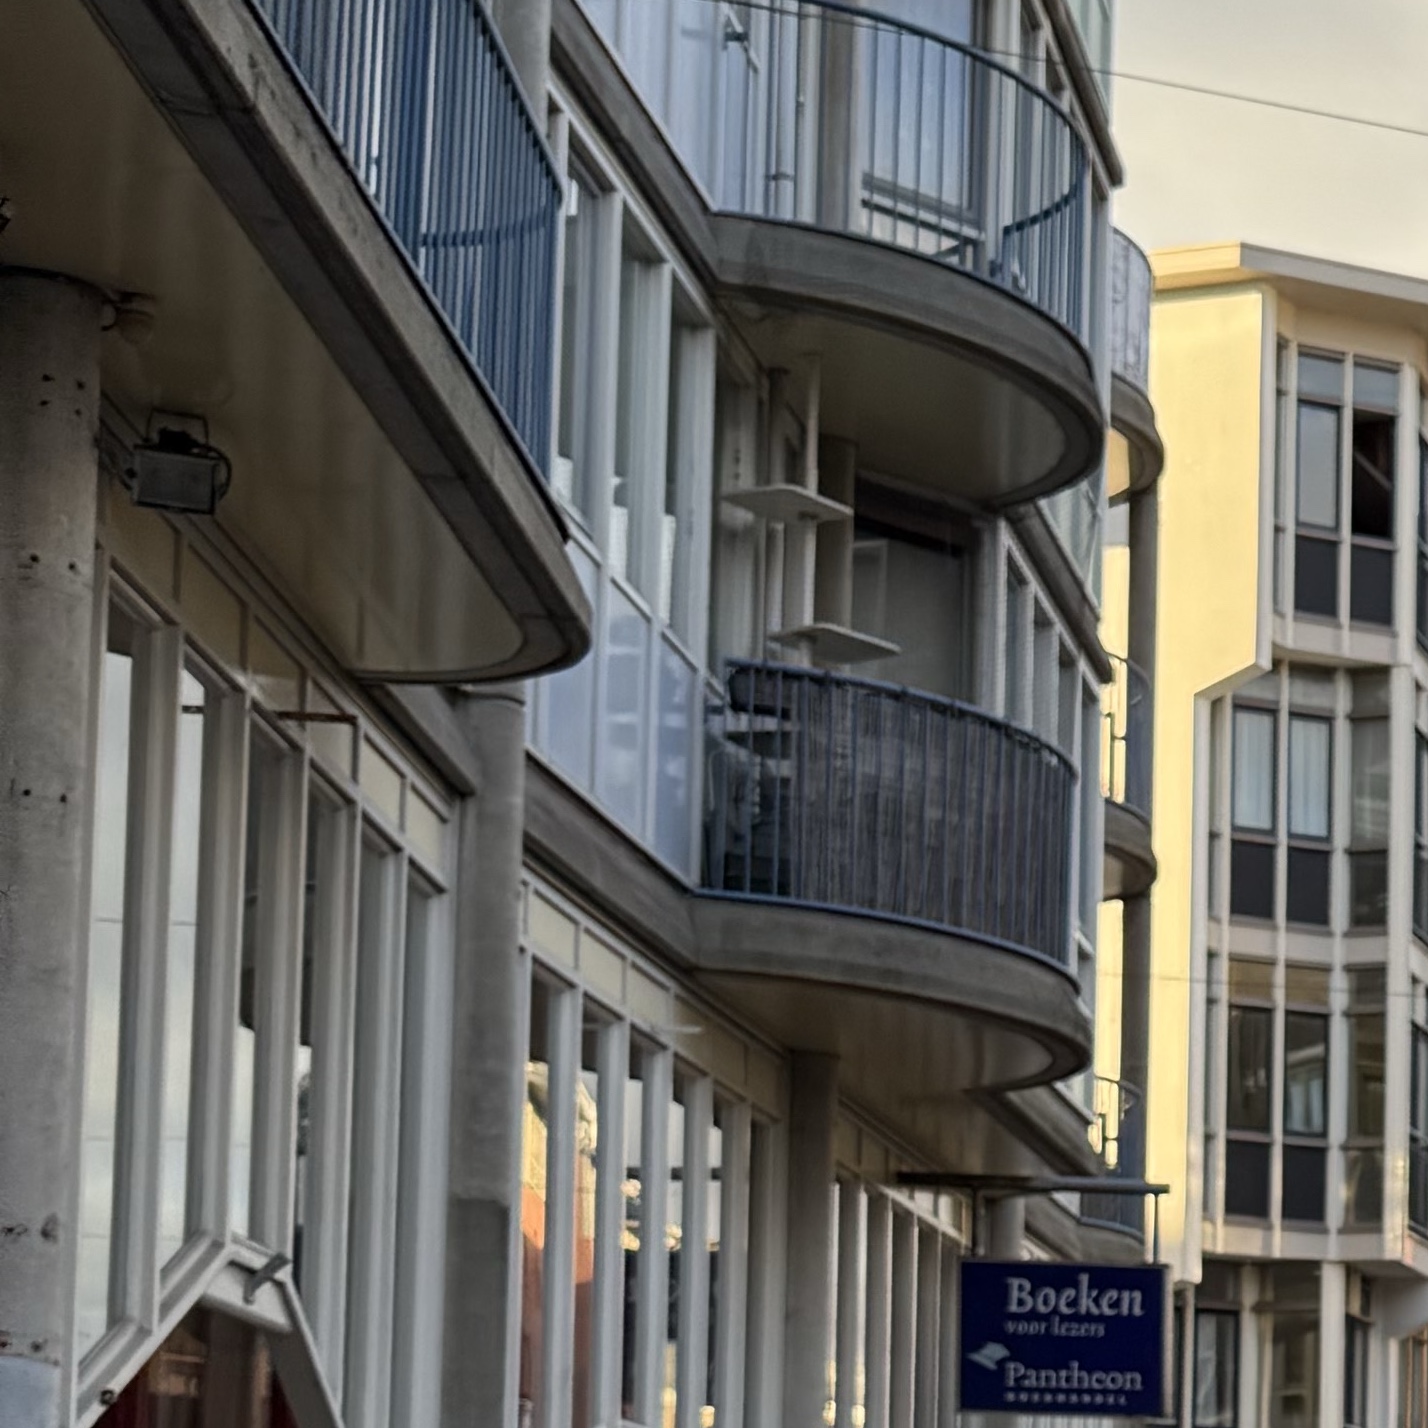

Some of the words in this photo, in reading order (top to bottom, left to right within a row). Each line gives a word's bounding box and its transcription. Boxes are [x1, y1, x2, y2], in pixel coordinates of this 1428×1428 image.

[1006, 1273, 1145, 1317] Boeken
[1005, 1320, 1048, 1336] voor
[1051, 1316, 1106, 1338] lezers
[1005, 1360, 1144, 1391] Pantheon
